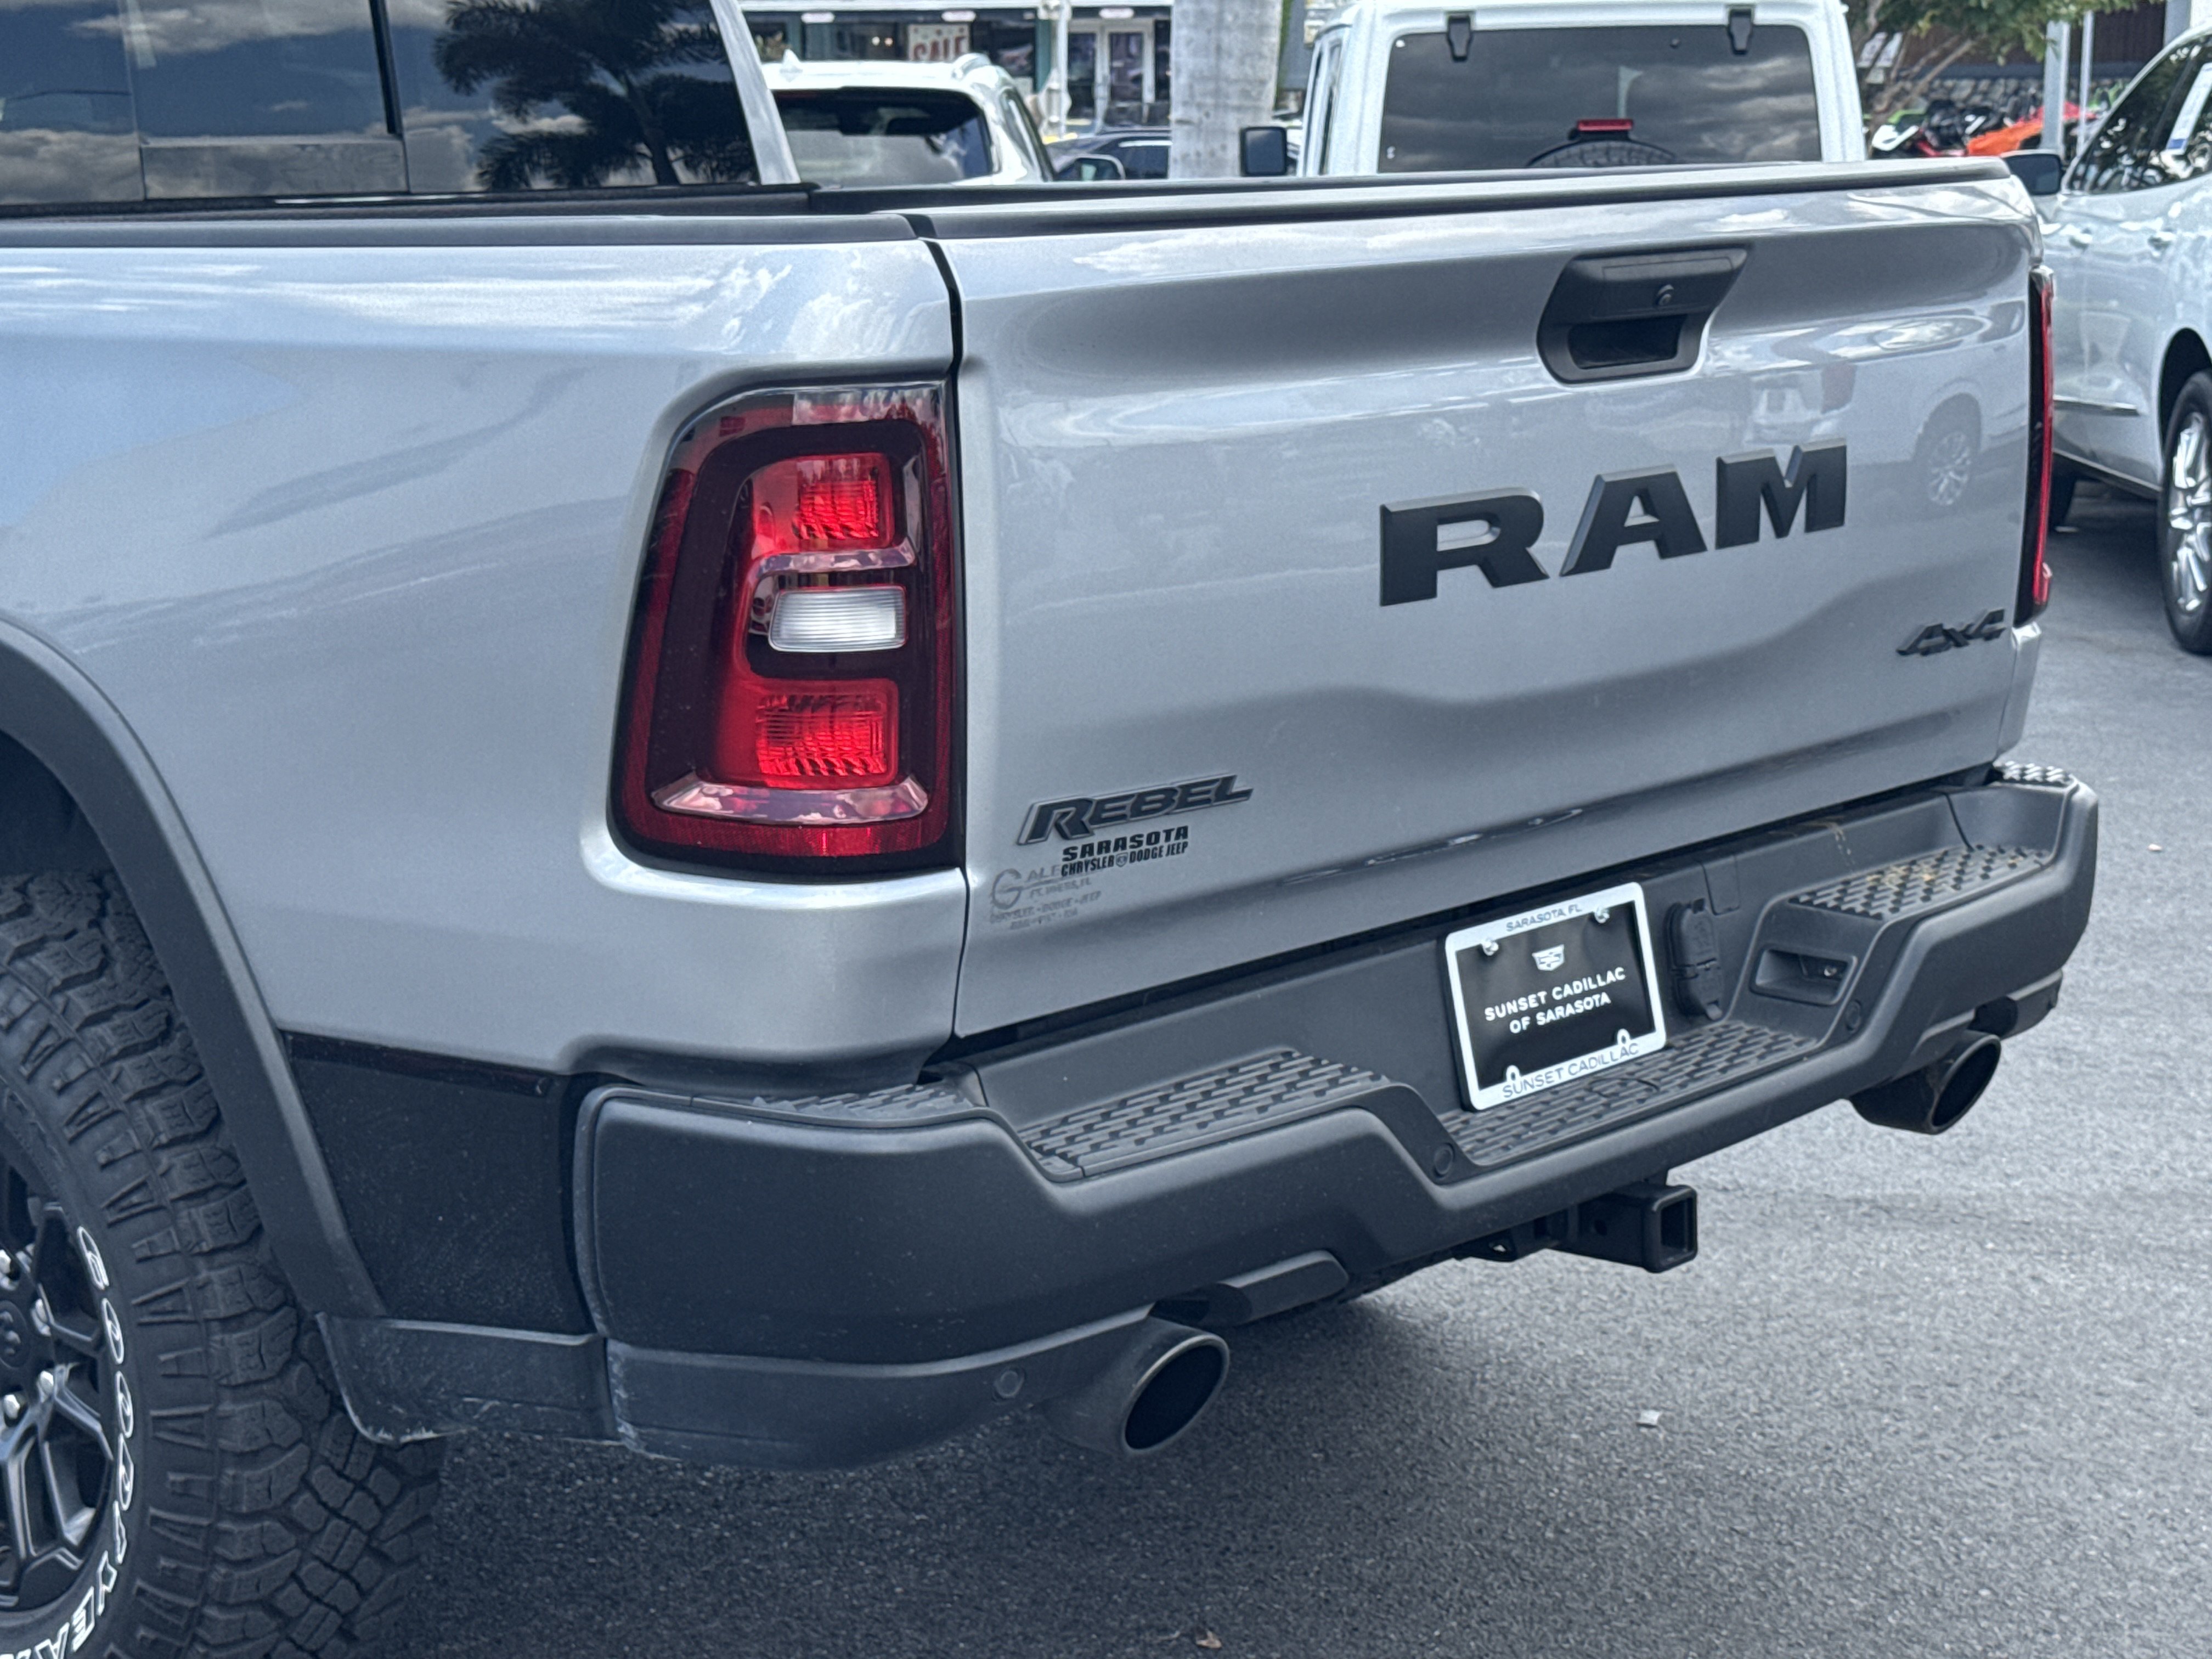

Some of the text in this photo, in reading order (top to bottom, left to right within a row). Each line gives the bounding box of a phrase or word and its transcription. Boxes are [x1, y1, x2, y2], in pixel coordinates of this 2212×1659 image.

[1379, 437, 1847, 606] RAM
[1016, 774, 1254, 846] REBEL
[1061, 841, 1188, 877] CHRYSLER DODGE JEEP
[1062, 825, 1188, 861] SARASOTA
[1506, 904, 1582, 932] SARASOTA FL
[1485, 967, 1626, 1022] SUNSET CADILLAC
[1509, 992, 1611, 1034] OF SARASOTA
[1502, 1042, 1640, 1098] SUNSET CADILLAC
